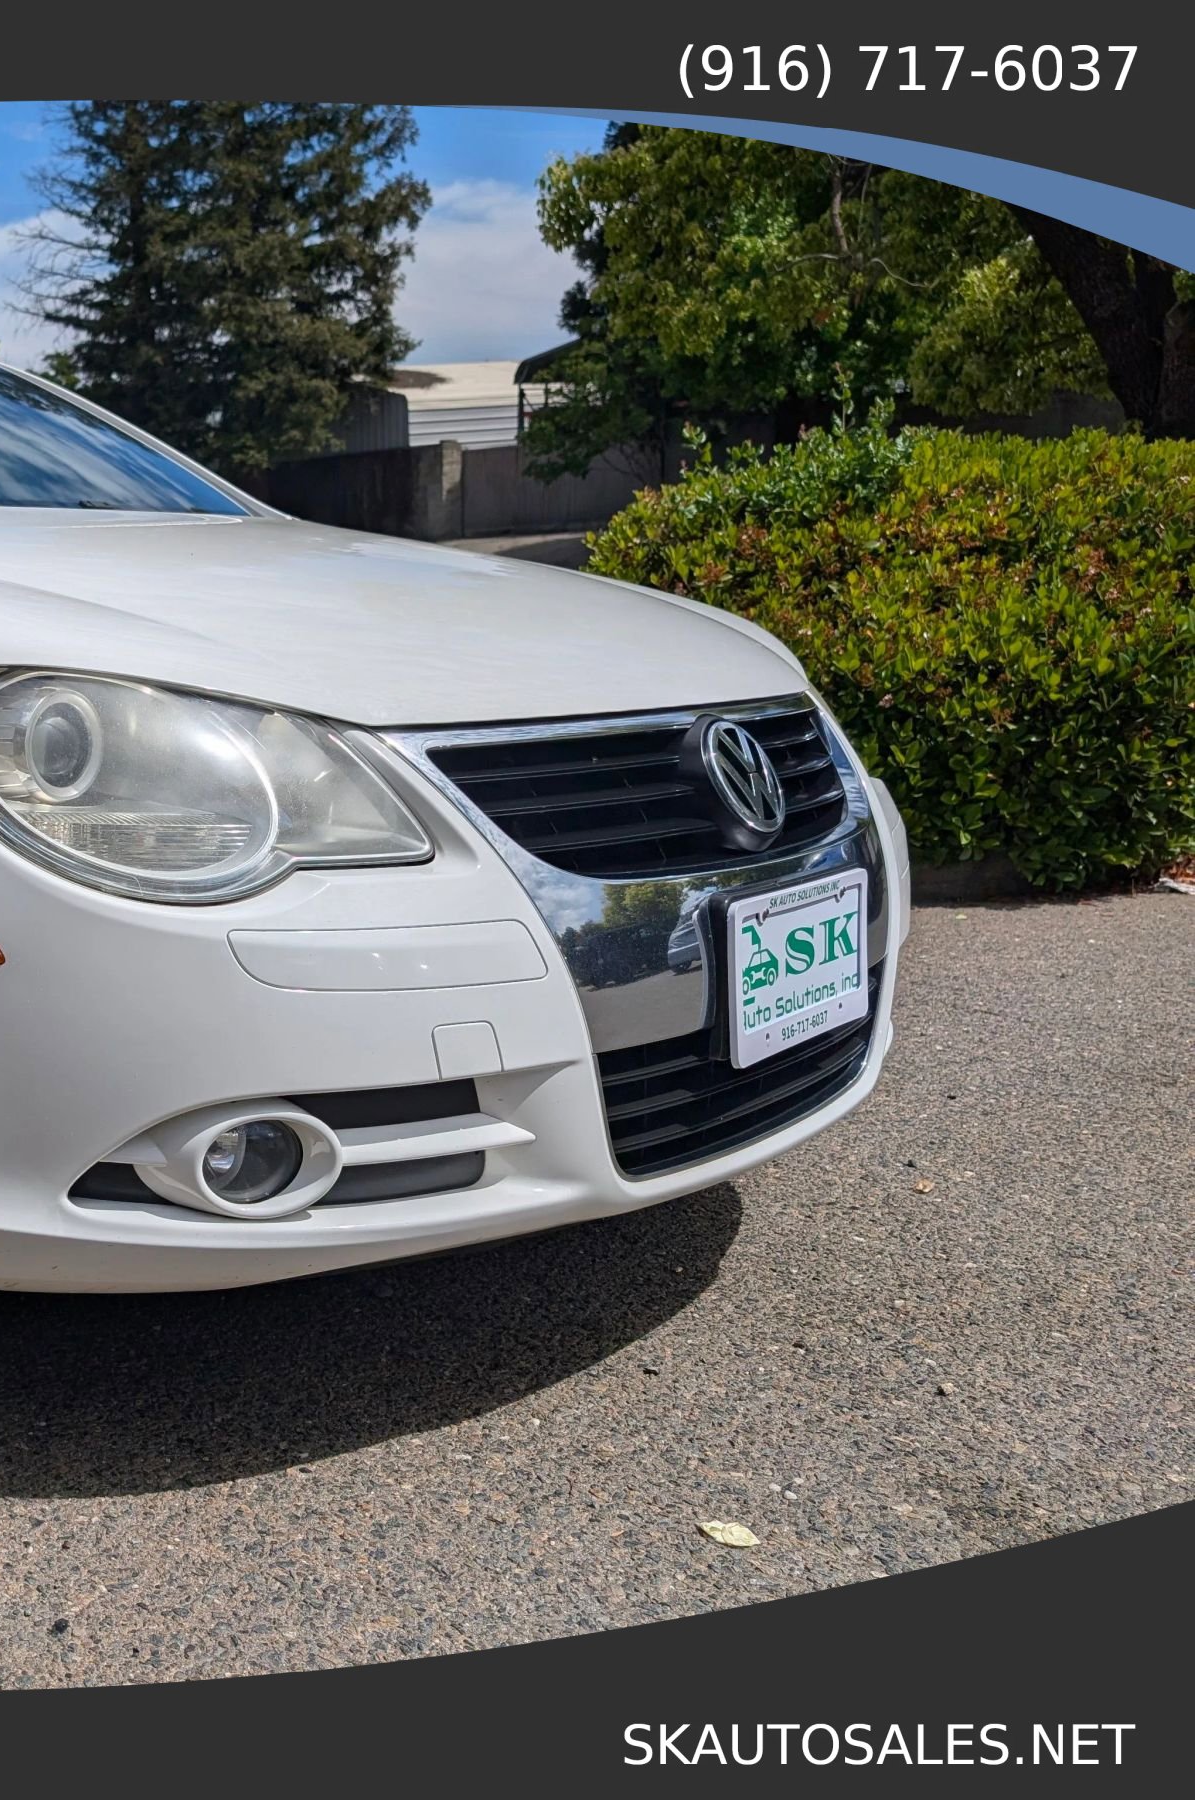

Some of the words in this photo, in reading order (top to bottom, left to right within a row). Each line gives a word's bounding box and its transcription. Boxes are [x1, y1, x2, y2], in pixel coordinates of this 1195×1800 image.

[769, 895, 779, 909] SK
[778, 892, 797, 907] AUTO
[796, 883, 830, 902] SOLUTIONS
[829, 880, 841, 892] INC
[785, 911, 858, 977] SK
[781, 1011, 829, 1041] 916-717-6037
